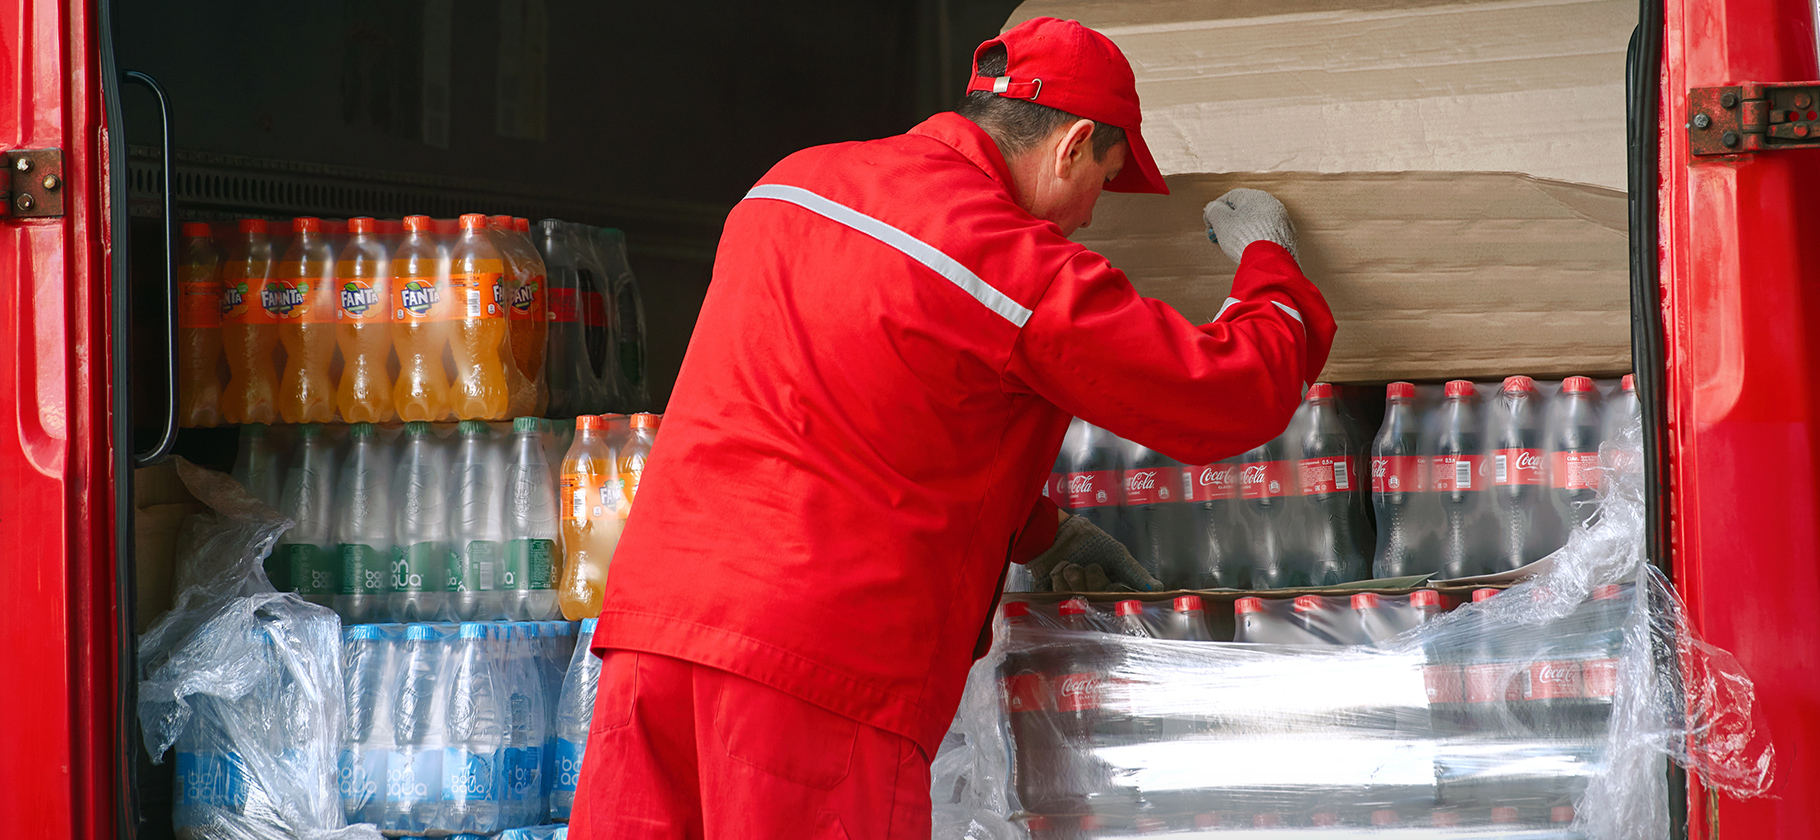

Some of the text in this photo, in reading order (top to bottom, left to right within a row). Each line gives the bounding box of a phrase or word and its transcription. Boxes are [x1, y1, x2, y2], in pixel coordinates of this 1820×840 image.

[341, 287, 379, 307] FANTA
[402, 287, 441, 307] FANTA
[451, 784, 485, 795] aqua
